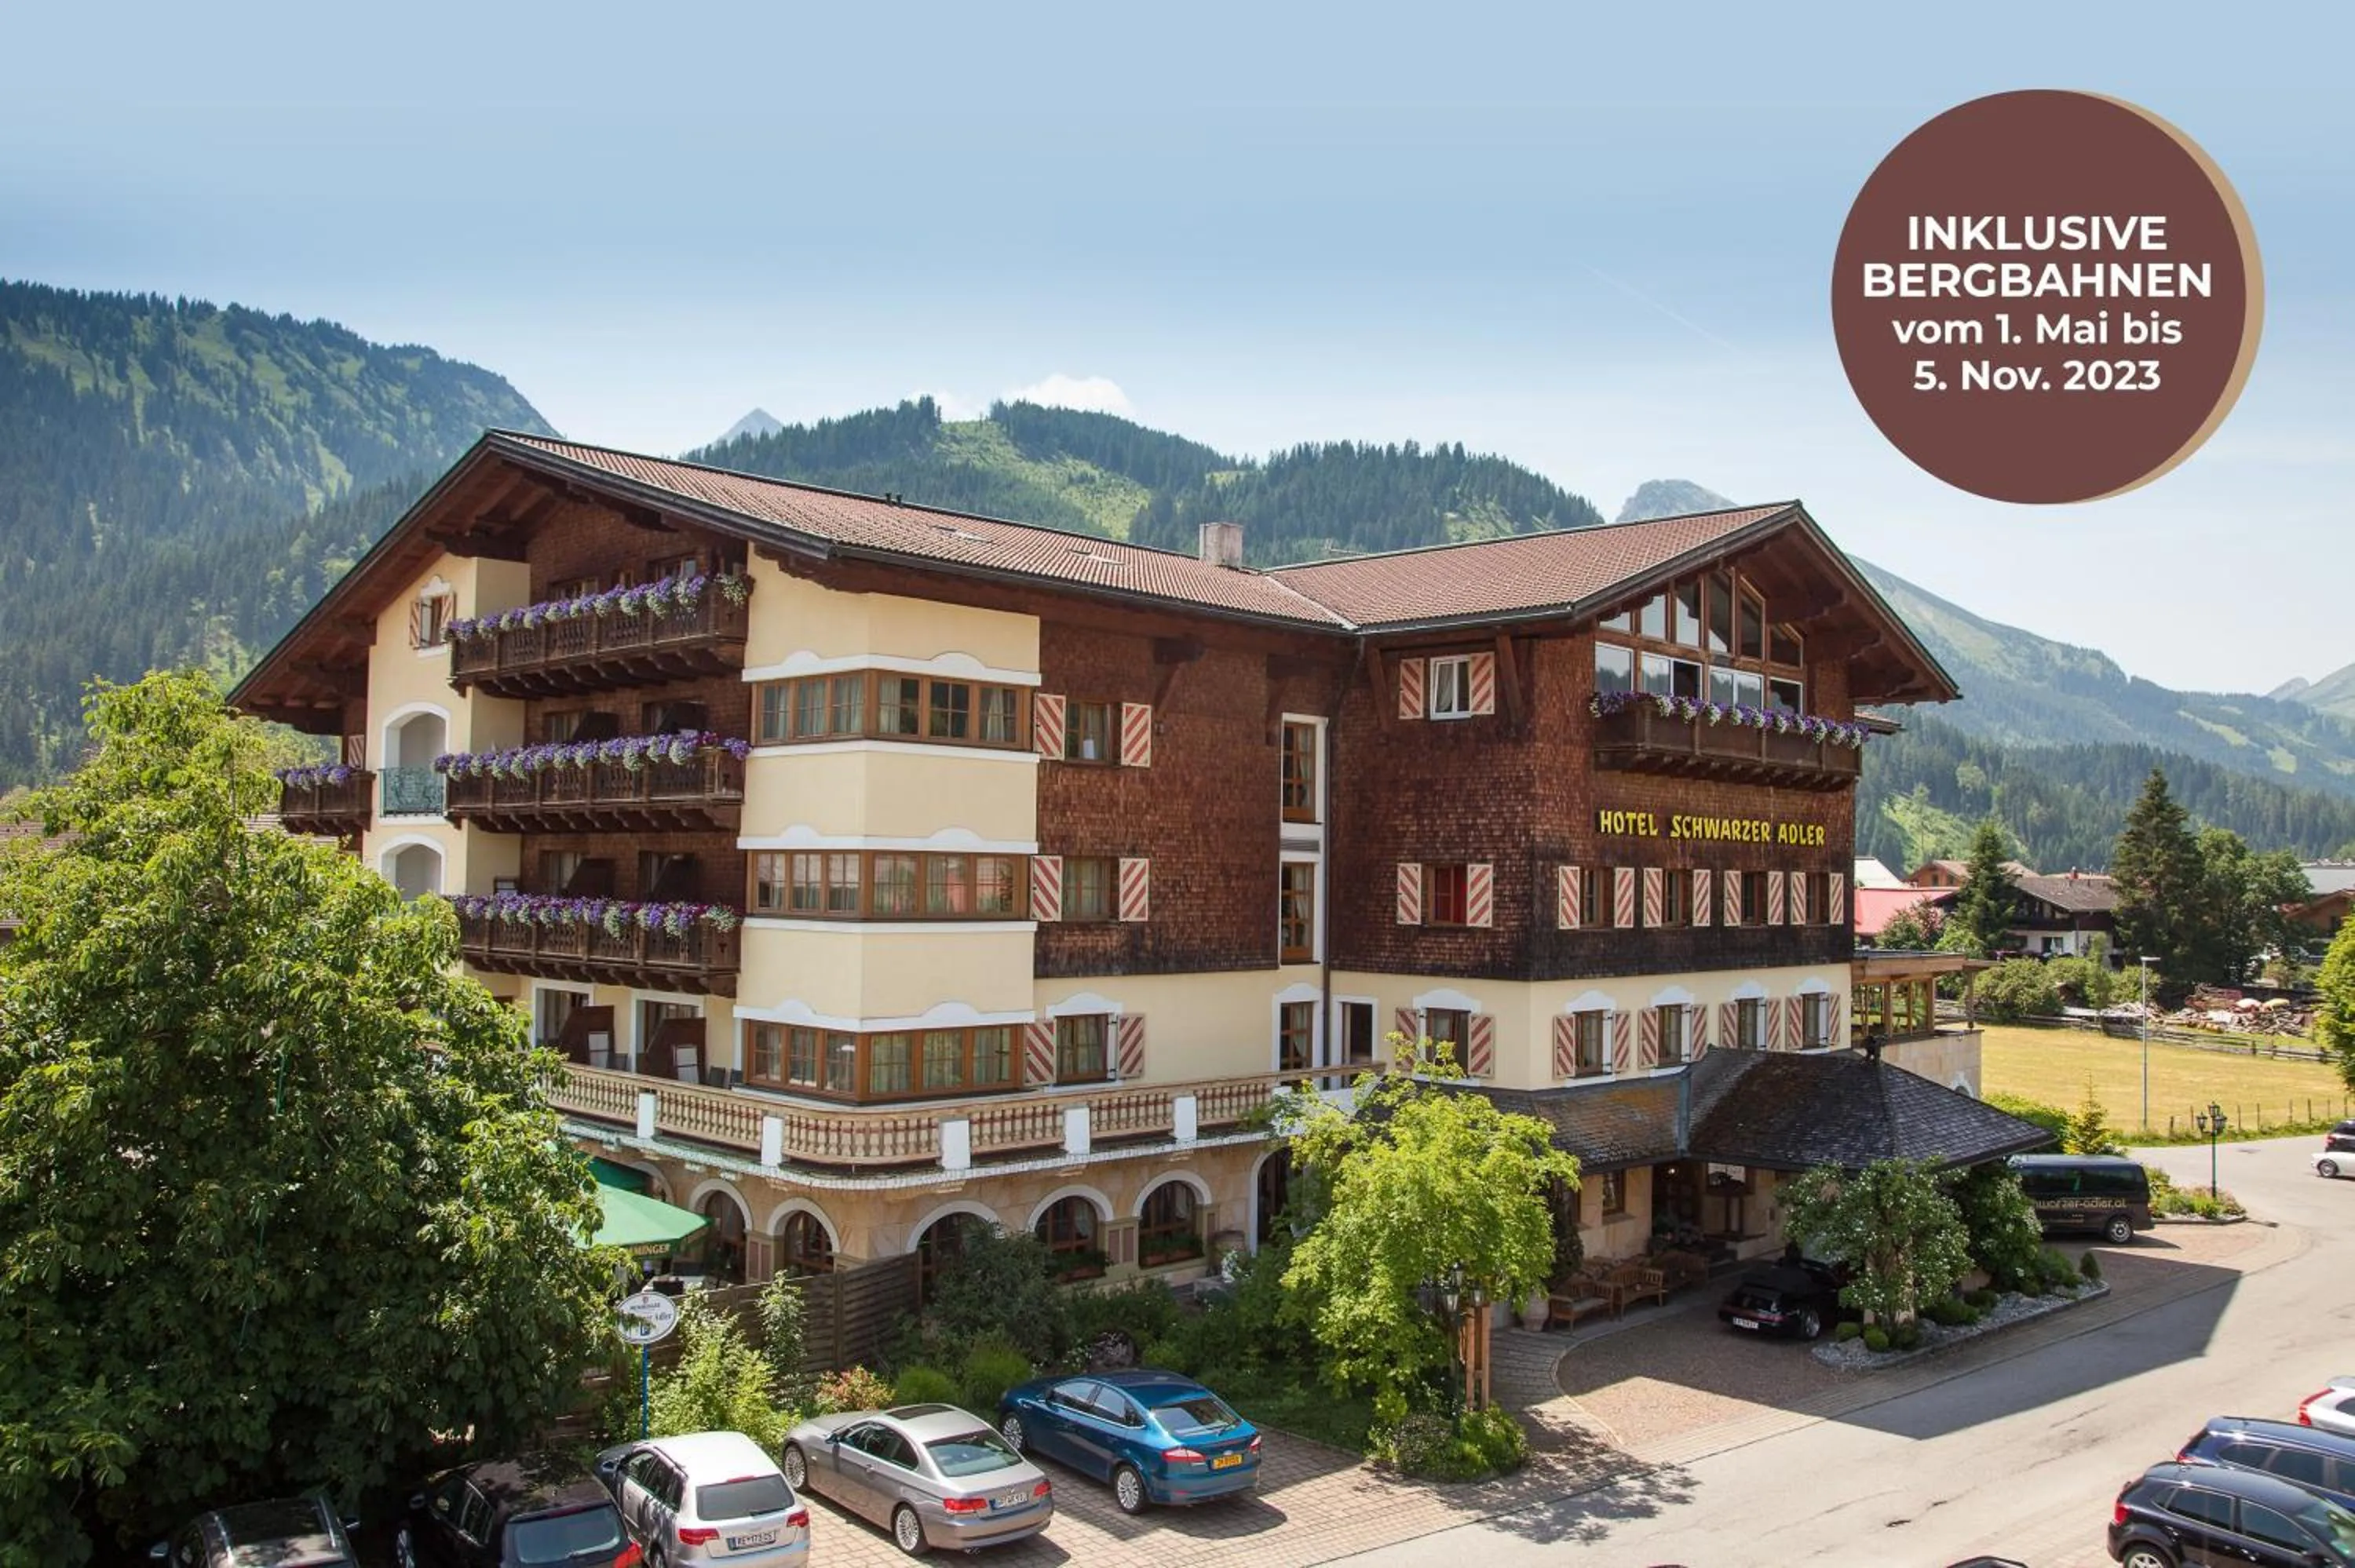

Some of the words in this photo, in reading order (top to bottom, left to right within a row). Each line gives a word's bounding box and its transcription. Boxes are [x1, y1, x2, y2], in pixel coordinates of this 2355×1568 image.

[1599, 810, 1659, 837] HOTEL
[1670, 815, 1771, 843] SCHWARZER
[1776, 822, 1826, 847] ADLER
